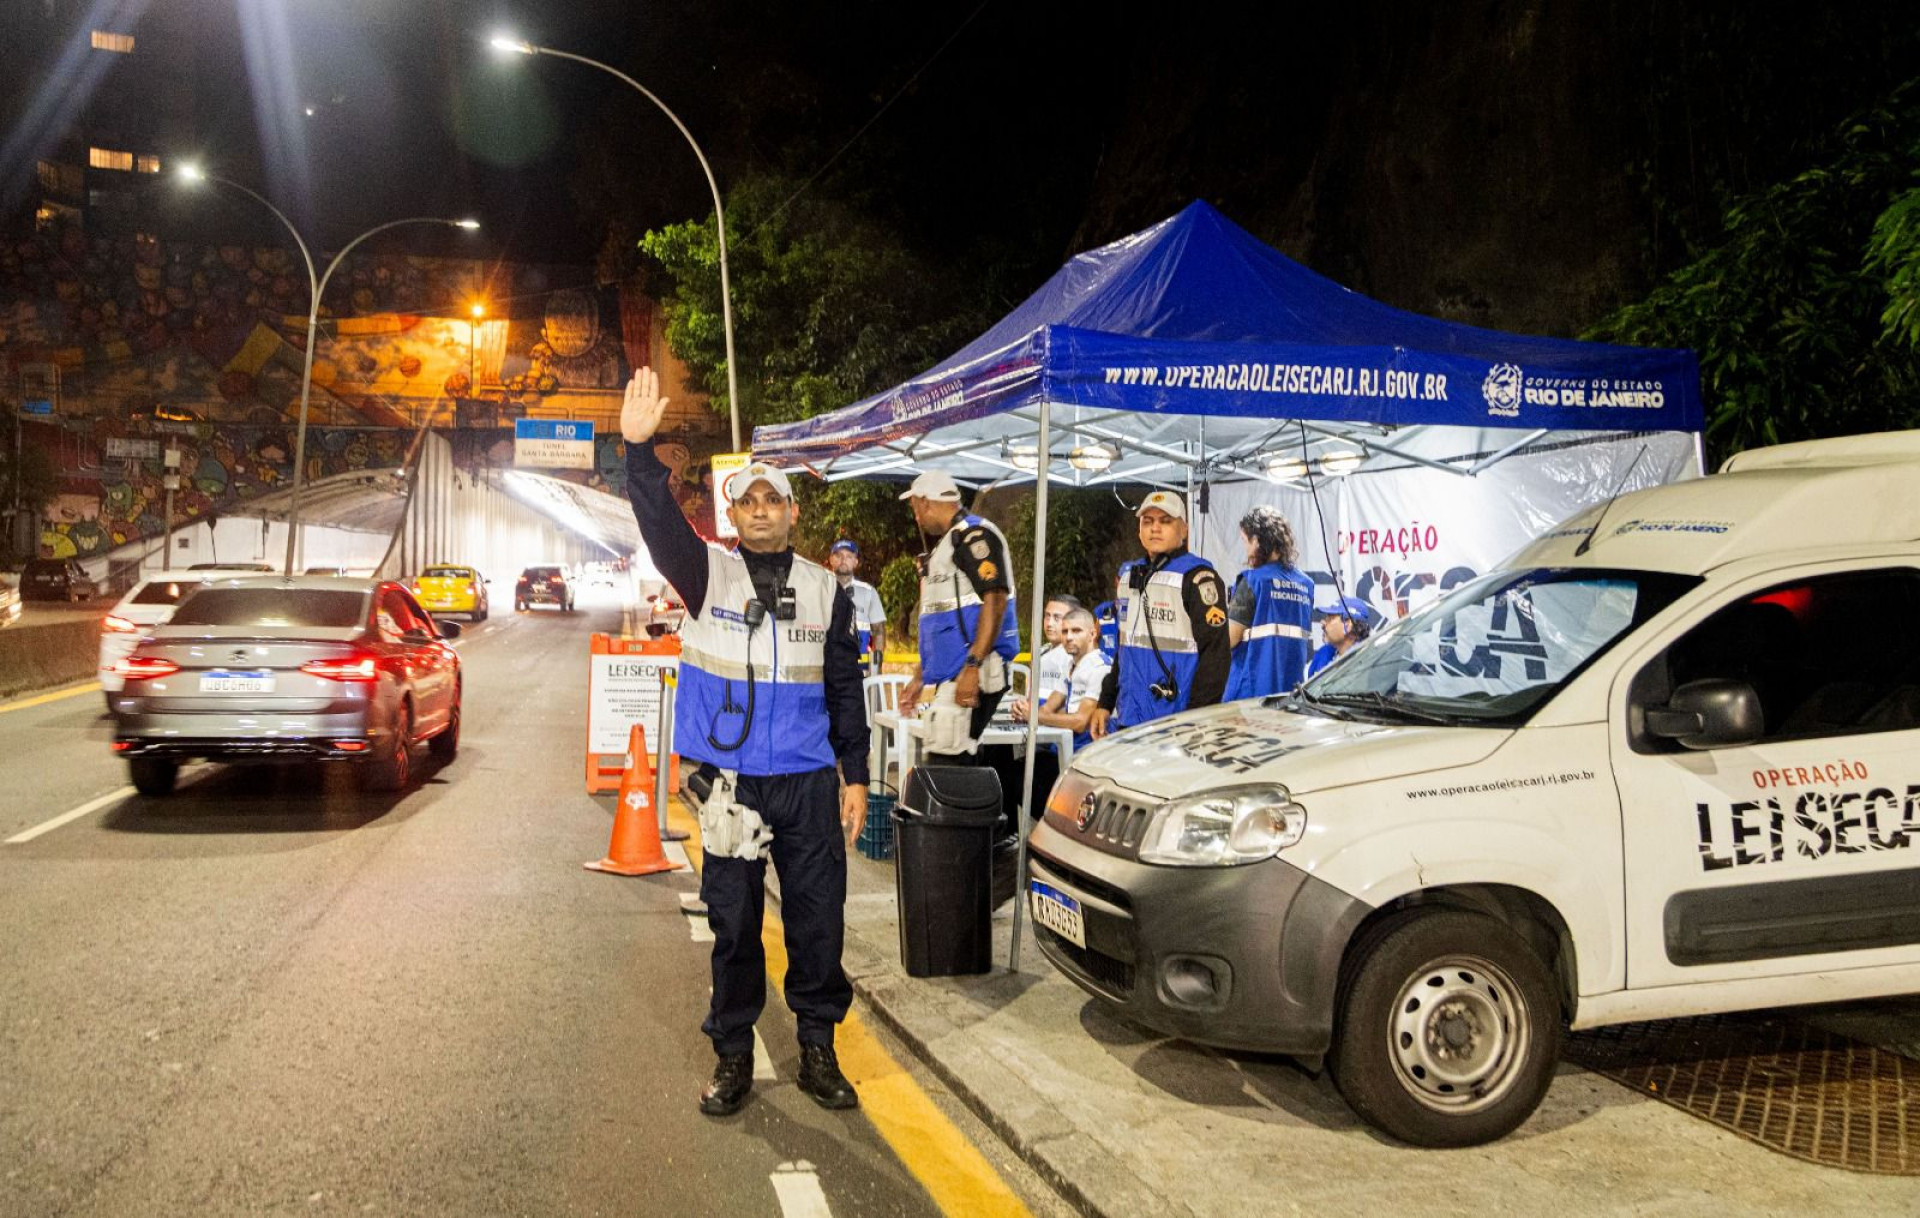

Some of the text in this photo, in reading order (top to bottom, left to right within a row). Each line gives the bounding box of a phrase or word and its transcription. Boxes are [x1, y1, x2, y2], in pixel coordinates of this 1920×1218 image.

[1525, 377, 1662, 390] GOVERNO DO ESTADO
[1524, 388, 1665, 409] RIO DE JANEIRO
[555, 424, 576, 436] RIO
[788, 628, 826, 643] LEI SEC
[608, 663, 628, 677] LEI
[1752, 759, 1869, 789] OPERAÇÃO
[1696, 796, 1785, 871] LEI
